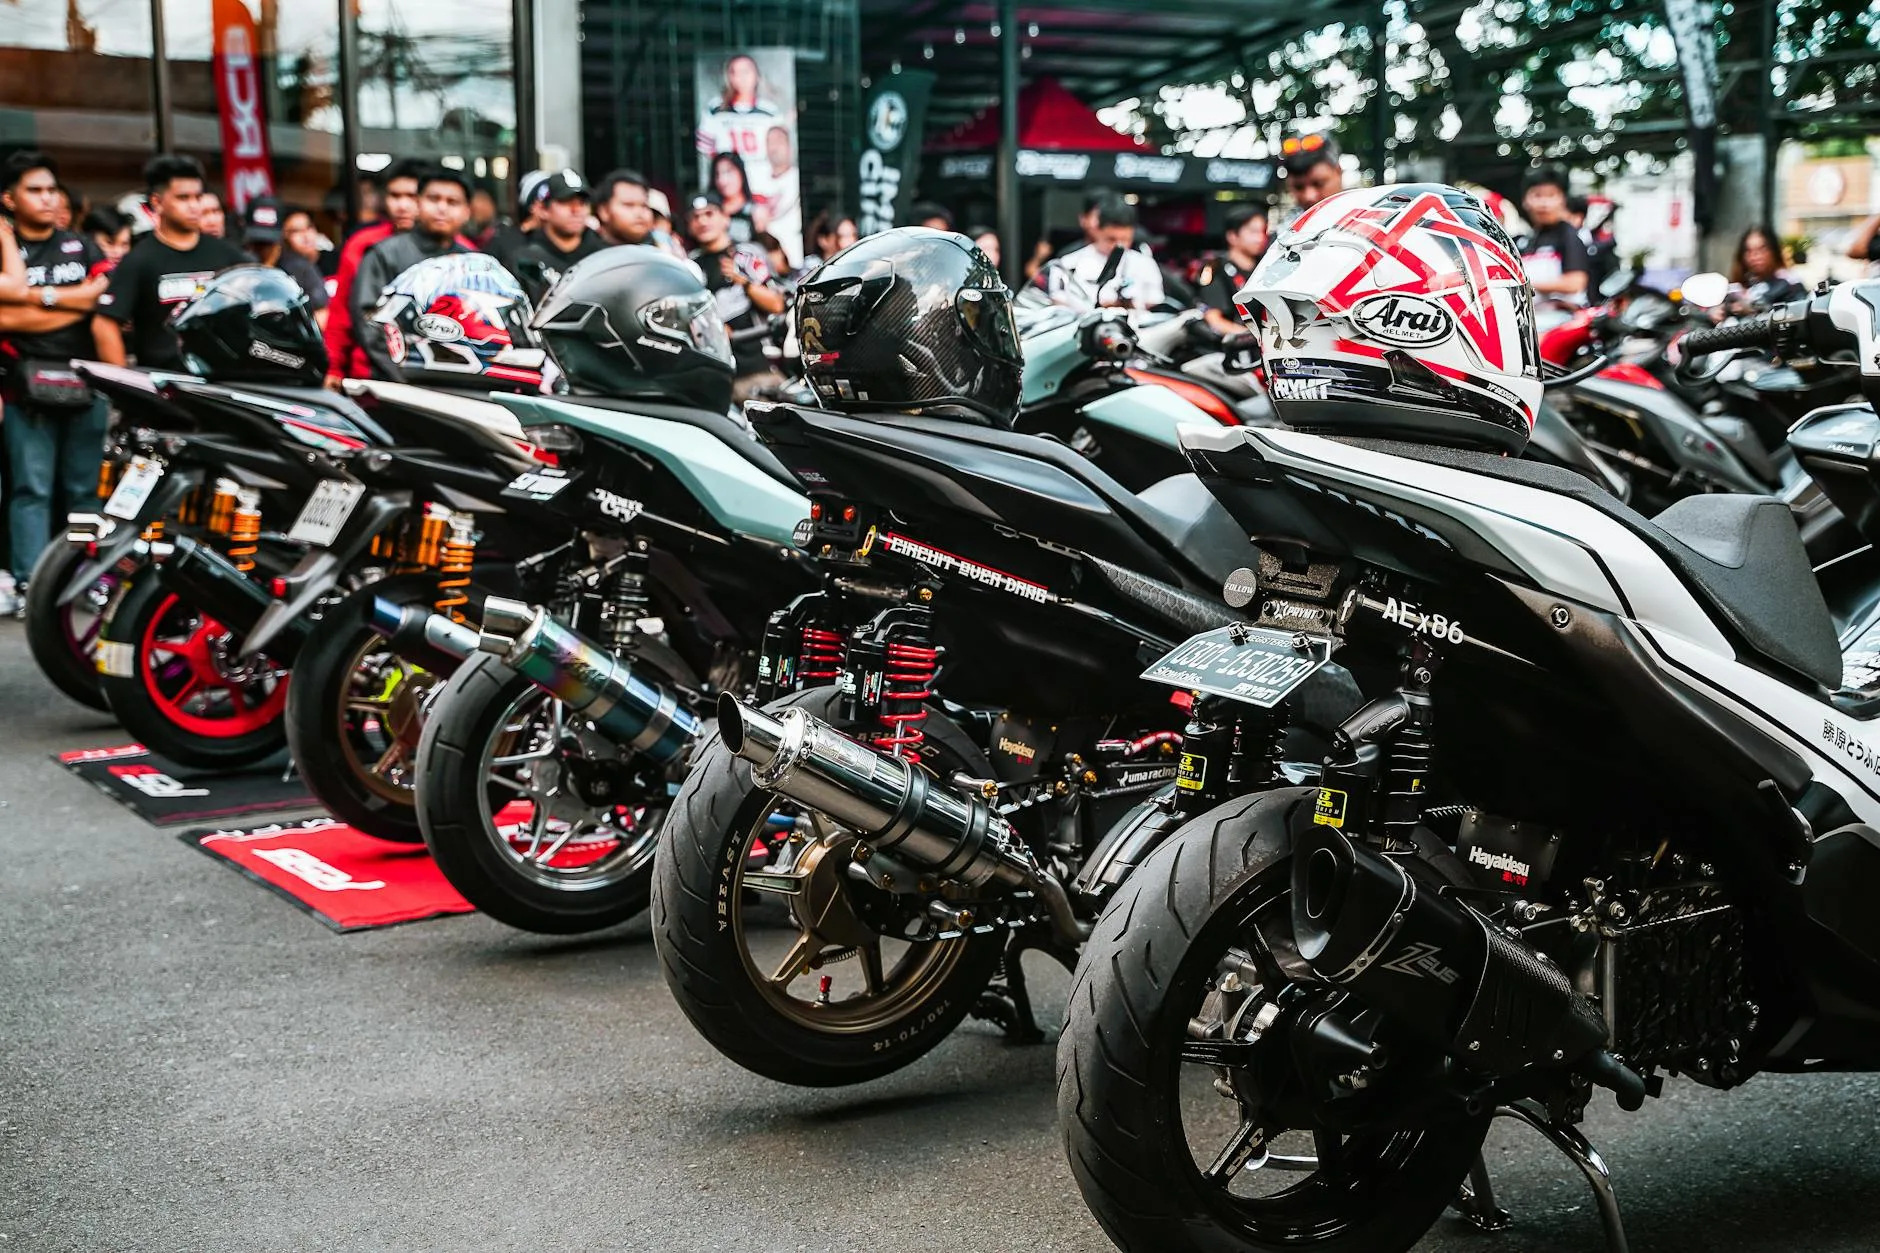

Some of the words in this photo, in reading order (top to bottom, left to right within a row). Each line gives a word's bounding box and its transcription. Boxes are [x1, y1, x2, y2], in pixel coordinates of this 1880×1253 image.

[1370, 297, 1444, 333] Arai
[600, 500, 638, 524] Cry
[792, 531, 814, 542] ONLY
[1224, 583, 1255, 595] FOLLOW
[1381, 596, 1464, 645] AEx86
[1128, 769, 1149, 784] uma
[1148, 766, 1177, 781] racing
[717, 830, 741, 916] BEAST
[1468, 845, 1531, 877] Hayaidesu
[1380, 941, 1462, 985] ZEUS
